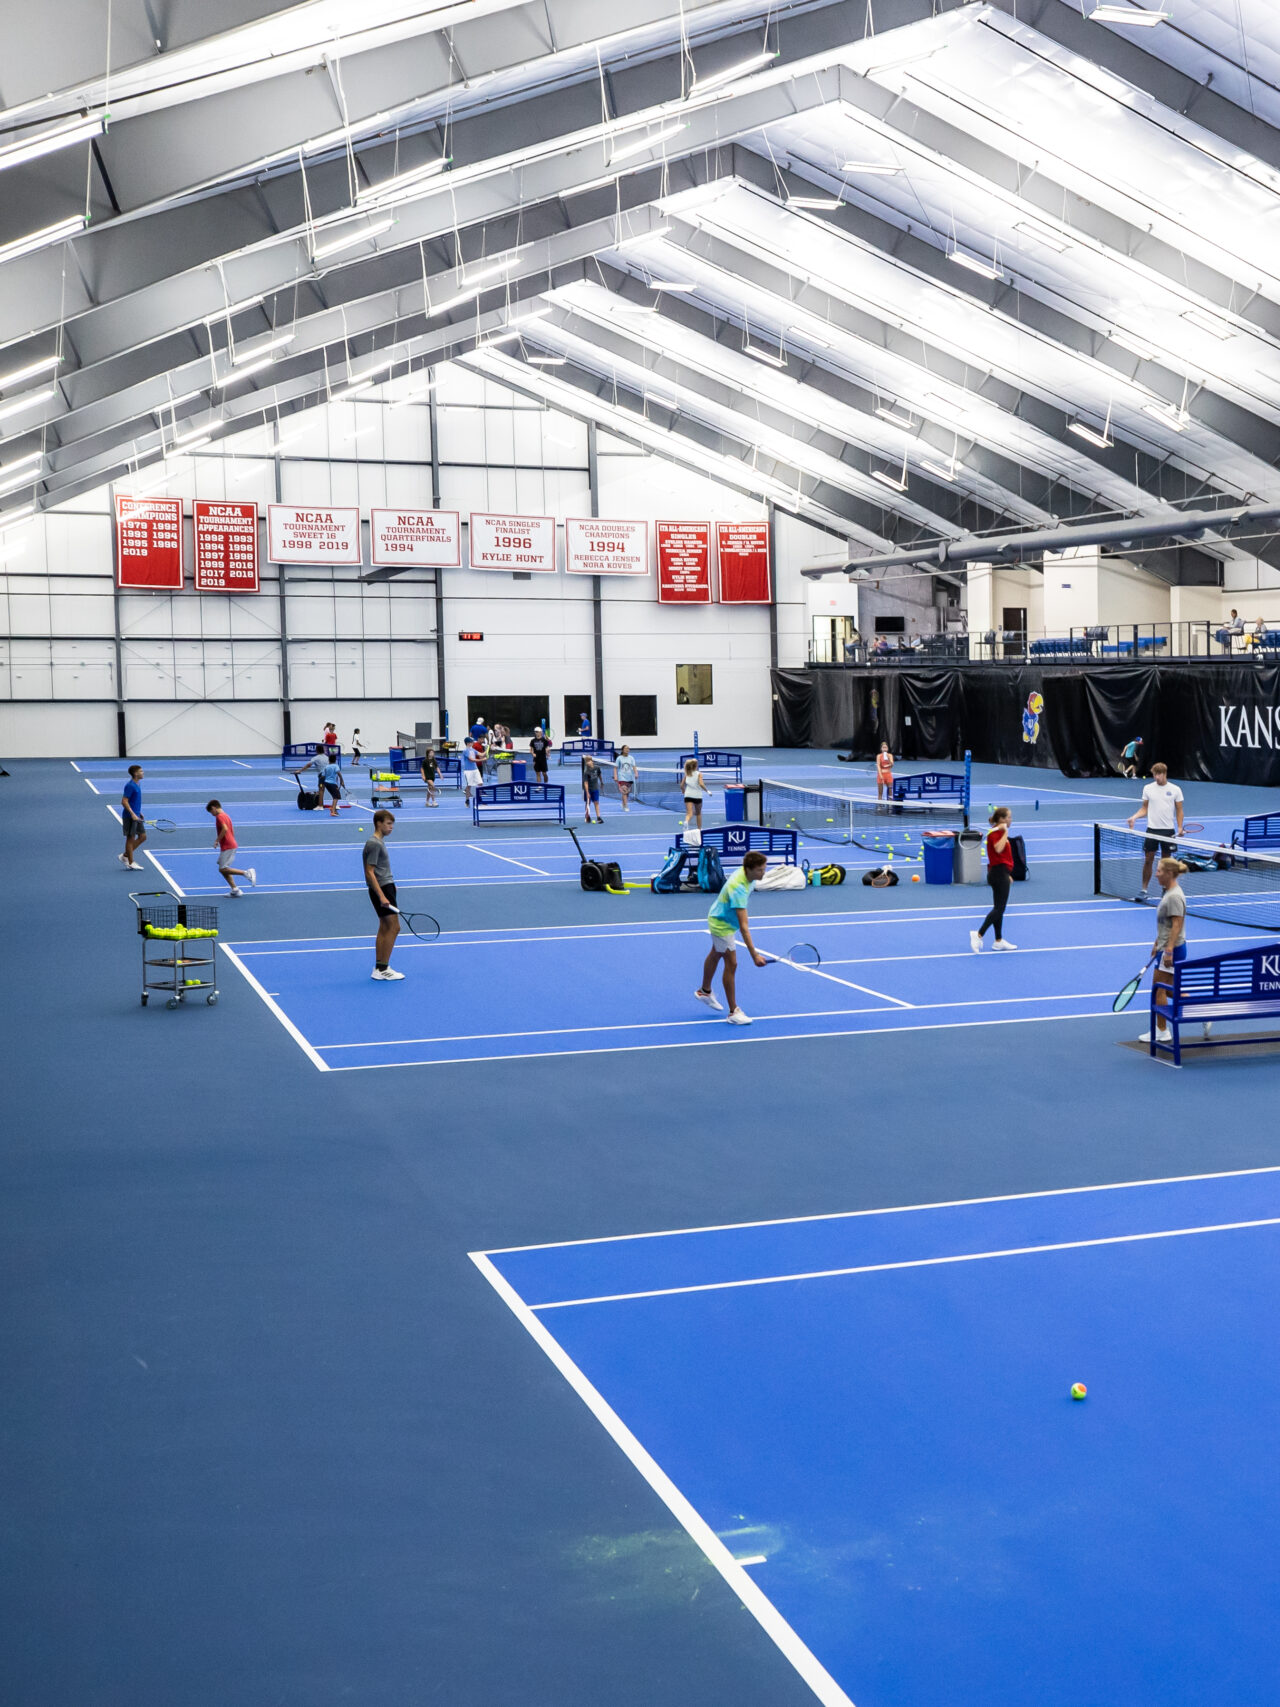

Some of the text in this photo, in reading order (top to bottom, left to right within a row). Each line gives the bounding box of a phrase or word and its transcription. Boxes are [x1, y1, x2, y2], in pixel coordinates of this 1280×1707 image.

[121, 501, 177, 512] CONRENCE
[121, 511, 178, 521] CAMPIONS
[208, 506, 243, 517] NCAA
[198, 515, 253, 525] TOURNAMENT
[295, 512, 334, 524] NCAA
[397, 515, 435, 527] NCAA
[152, 522, 178, 531] 1992
[198, 524, 254, 533] APPEARANCES
[282, 523, 346, 532] TOURNAMENT
[485, 519, 541, 529] NCAA SINGLES
[579, 524, 636, 533] NCAA DOUBLES
[385, 526, 447, 535] TOURNAMENT
[495, 527, 531, 535] FINALIST
[152, 531, 178, 540] 1994
[199, 533, 224, 542] 1992
[293, 531, 337, 540] SWEET 16
[380, 534, 452, 543] QUARTERFINALS
[585, 531, 630, 540] CHAMPIONS
[122, 539, 178, 549] 1995 1996
[199, 542, 225, 551] 1994
[281, 540, 349, 550] 1998 2019
[493, 535, 532, 549] 1996
[589, 540, 626, 553] 1994
[384, 543, 414, 552] 1994
[199, 551, 225, 560] 1997
[481, 552, 545, 564] KYLIE HUNT
[574, 554, 641, 563] REBECCA JENSEN
[229, 561, 254, 569] 2016
[607, 562, 633, 570] KOVES
[200, 569, 254, 578] 2017 2018
[200, 578, 226, 587] 2019
[513, 785, 527, 794] KU
[728, 830, 746, 844] KU
